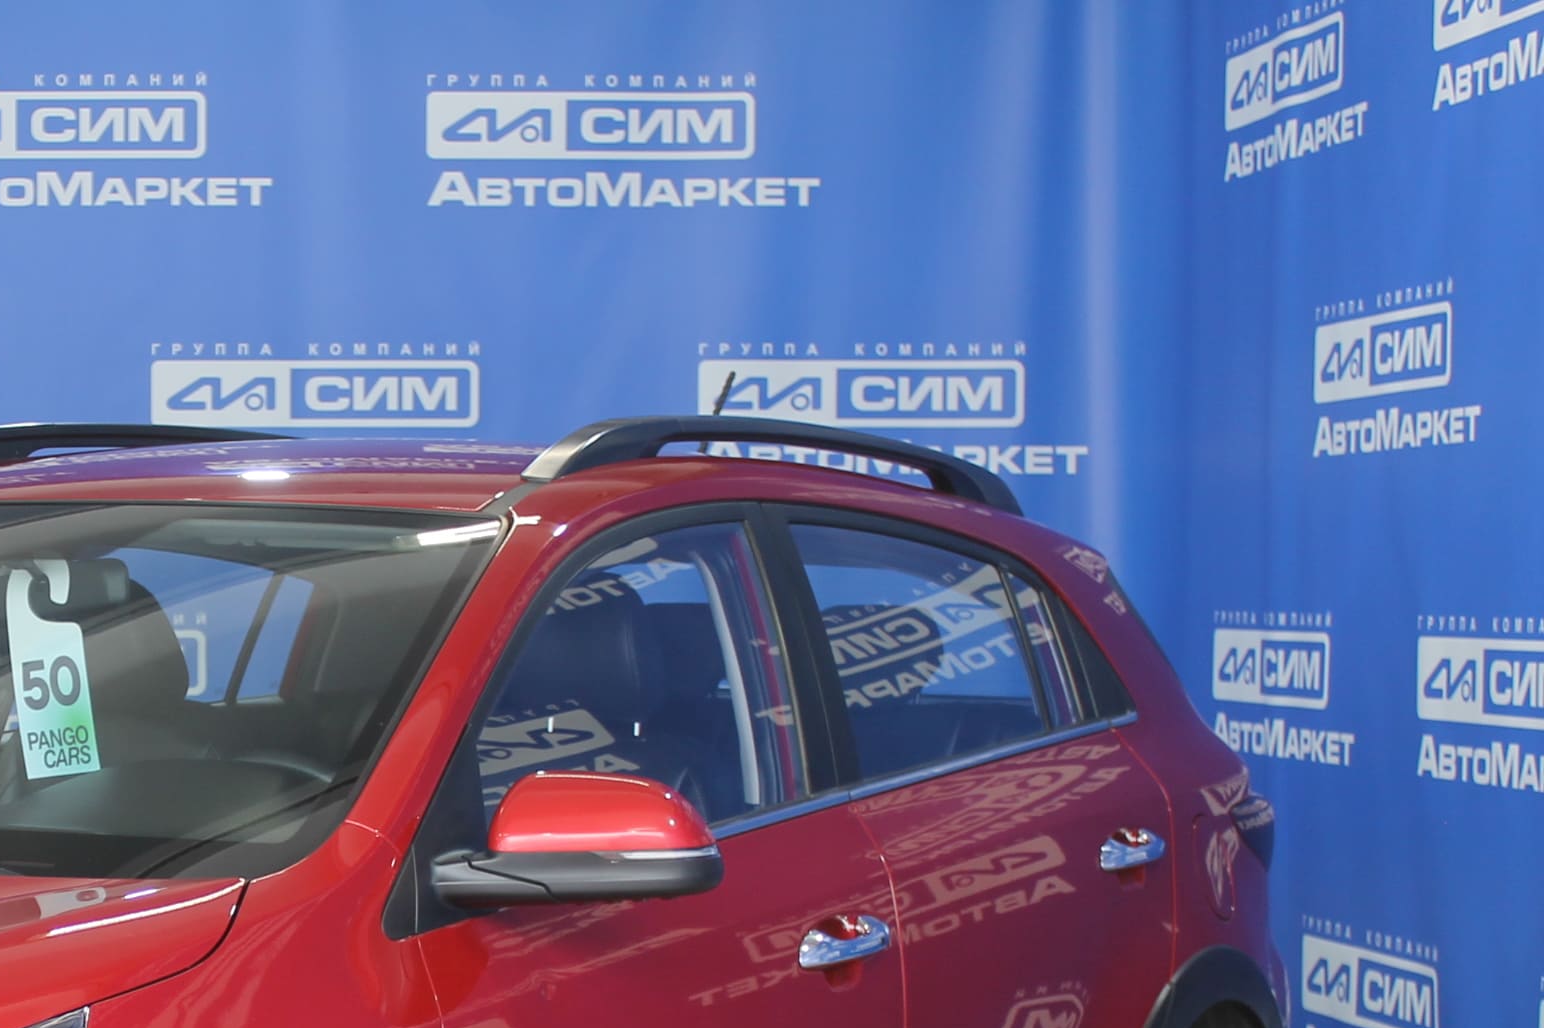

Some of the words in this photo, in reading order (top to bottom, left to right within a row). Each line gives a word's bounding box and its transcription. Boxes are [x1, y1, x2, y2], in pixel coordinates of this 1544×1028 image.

[1275, 32, 1336, 92] СИМ
[35, 72, 208, 88] КОМПАНИЙ
[427, 74, 548, 88] ГРУППА
[586, 72, 755, 88] КОМПАНИЙ
[31, 107, 184, 142] СИМ
[581, 108, 734, 143] СИМ
[152, 343, 272, 356] ГРУППА
[309, 340, 480, 356] КОМПАНИЙ
[699, 342, 818, 356] ГРУППА
[855, 341, 1026, 356] КОМПАНИЙ
[1374, 323, 1443, 376] СИМ
[305, 376, 457, 411] СИМ
[851, 376, 1003, 411] СИМ
[22, 656, 80, 710] 50
[1264, 649, 1320, 689] СИМ
[1491, 660, 1544, 707] СИ
[28, 726, 89, 750] PANGO
[44, 747, 91, 768] CARS
[1363, 969, 1432, 1028] СИМ
